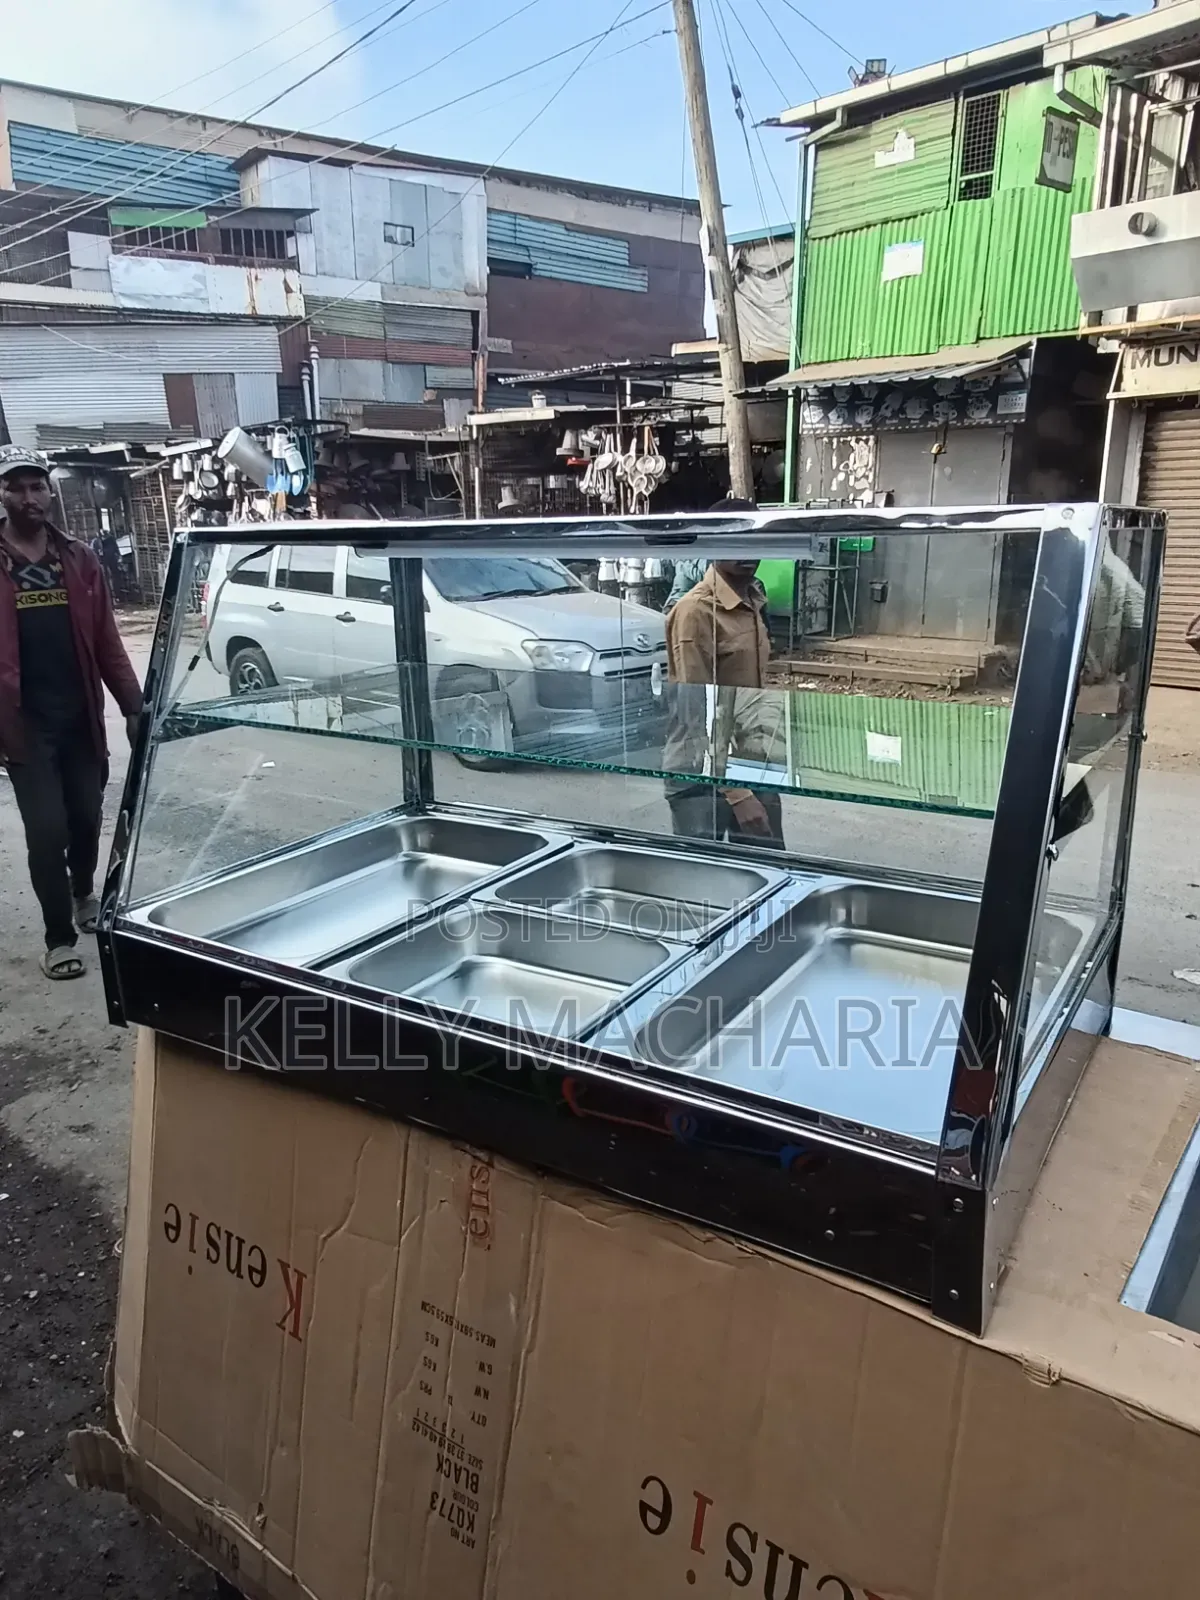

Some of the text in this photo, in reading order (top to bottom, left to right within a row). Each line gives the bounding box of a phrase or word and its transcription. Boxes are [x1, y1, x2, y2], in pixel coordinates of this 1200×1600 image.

[1130, 344, 1199, 370] MUN
[163, 1202, 308, 1343] Kensie
[425, 1331, 440, 1348] KGS
[422, 1355, 437, 1373] KGS
[435, 1452, 480, 1495] BLACK
[429, 1491, 475, 1534] KQ773
[461, 1533, 476, 1550] ART
[638, 1475, 884, 1600] nsie
